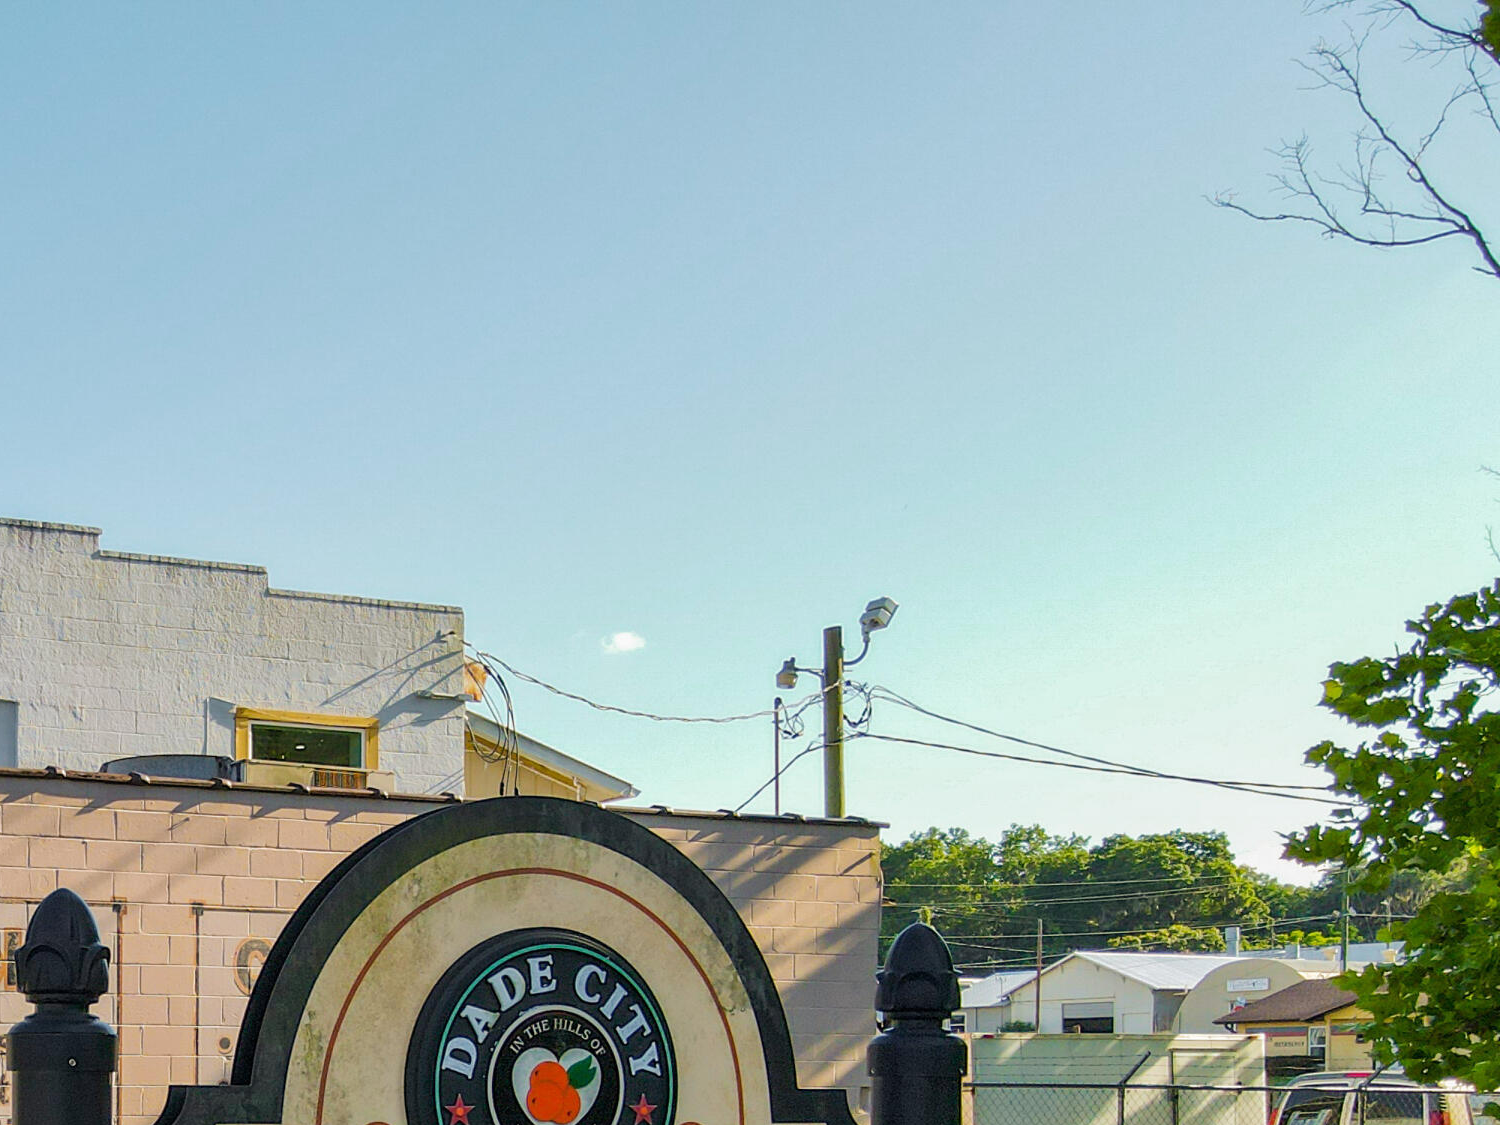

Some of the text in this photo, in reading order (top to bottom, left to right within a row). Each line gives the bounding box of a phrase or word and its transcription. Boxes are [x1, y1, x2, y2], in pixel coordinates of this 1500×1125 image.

[441, 954, 662, 1080] DADE CITY
[523, 1019, 550, 1039] THE
[553, 1018, 591, 1040] HILLS
[590, 1039, 606, 1056] OF
